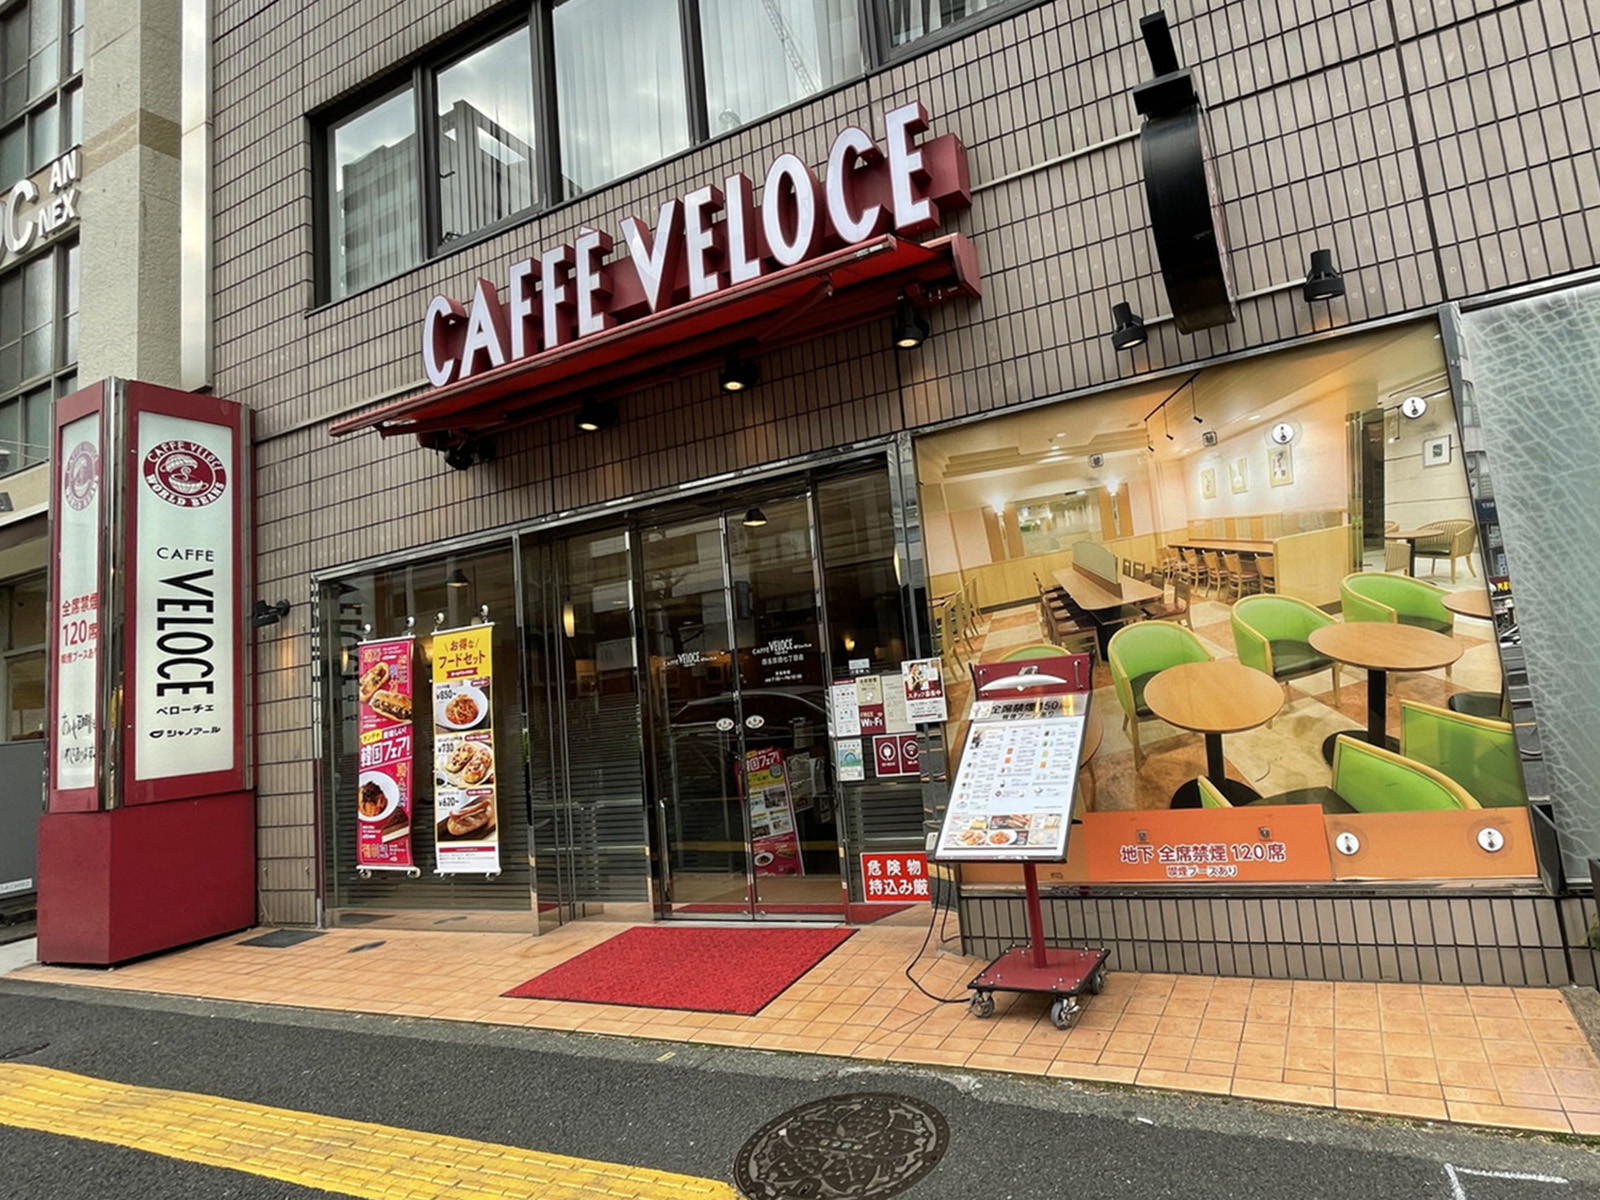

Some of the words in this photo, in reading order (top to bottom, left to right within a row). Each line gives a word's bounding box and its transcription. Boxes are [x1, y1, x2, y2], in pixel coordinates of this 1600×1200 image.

[49, 150, 81, 194] AN
[39, 188, 80, 238] NEX
[619, 101, 940, 313] VELOCE
[146, 441, 185, 463] CAFFE
[190, 442, 224, 471] VELOCE
[146, 473, 187, 507] WORLD
[191, 481, 225, 507] BEANS
[156, 547, 214, 562] CAFFE
[156, 569, 214, 697] VELOCE
[450, 637, 474, 651] お得な
[438, 650, 485, 669] フードセット
[156, 704, 215, 716] ベローチェ
[167, 726, 221, 737] シャノアール
[860, 717, 883, 727] Wi-Fi
[1120, 845, 1154, 863] 地下
[1159, 843, 1228, 864] 全席禁煙
[1231, 842, 1287, 863] 120席
[1166, 865, 1238, 878] 喫煙ブースあり
